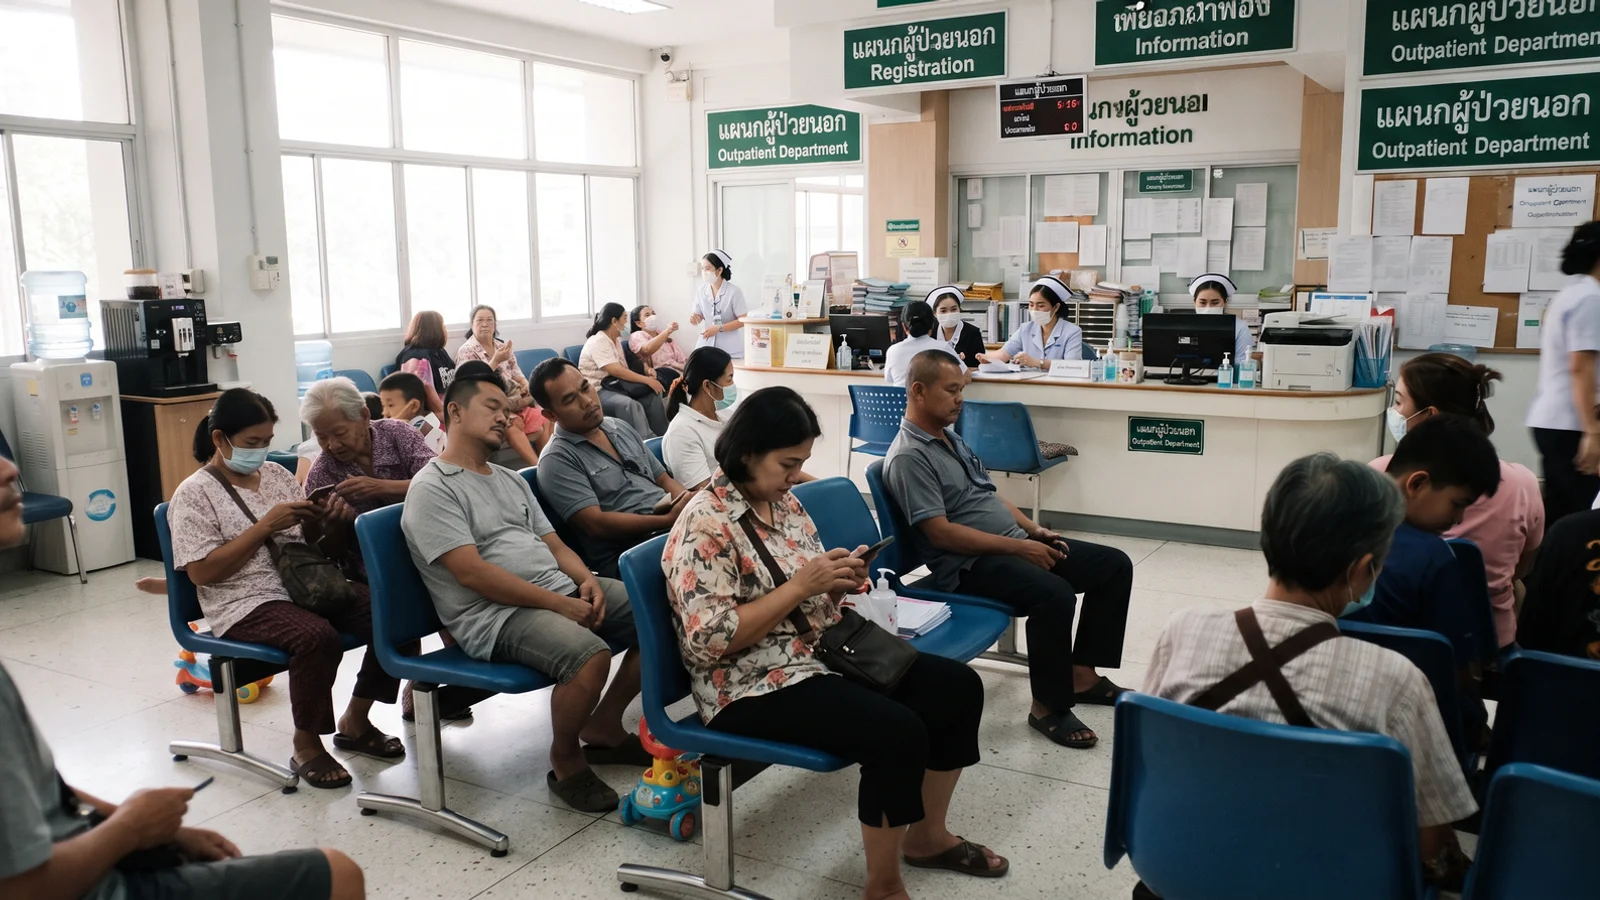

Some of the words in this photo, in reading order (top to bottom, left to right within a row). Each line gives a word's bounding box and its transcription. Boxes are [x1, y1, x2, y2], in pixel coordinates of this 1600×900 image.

[852, 25, 996, 62] แผนกผู้ป่วยนอก
[1135, 29, 1249, 56] Information
[1391, 38, 1487, 64] Outpatient
[1493, 31, 1600, 56] Departmen
[870, 56, 975, 83] Registration
[1376, 89, 1590, 134] แผนกผู้ป่วยนอก
[718, 110, 847, 145] แผนกผู้ป่วยนอก
[718, 145, 776, 164] Outpatient
[779, 141, 848, 160] Department
[1372, 138, 1467, 162] Outpatient
[1475, 132, 1590, 157] Department
